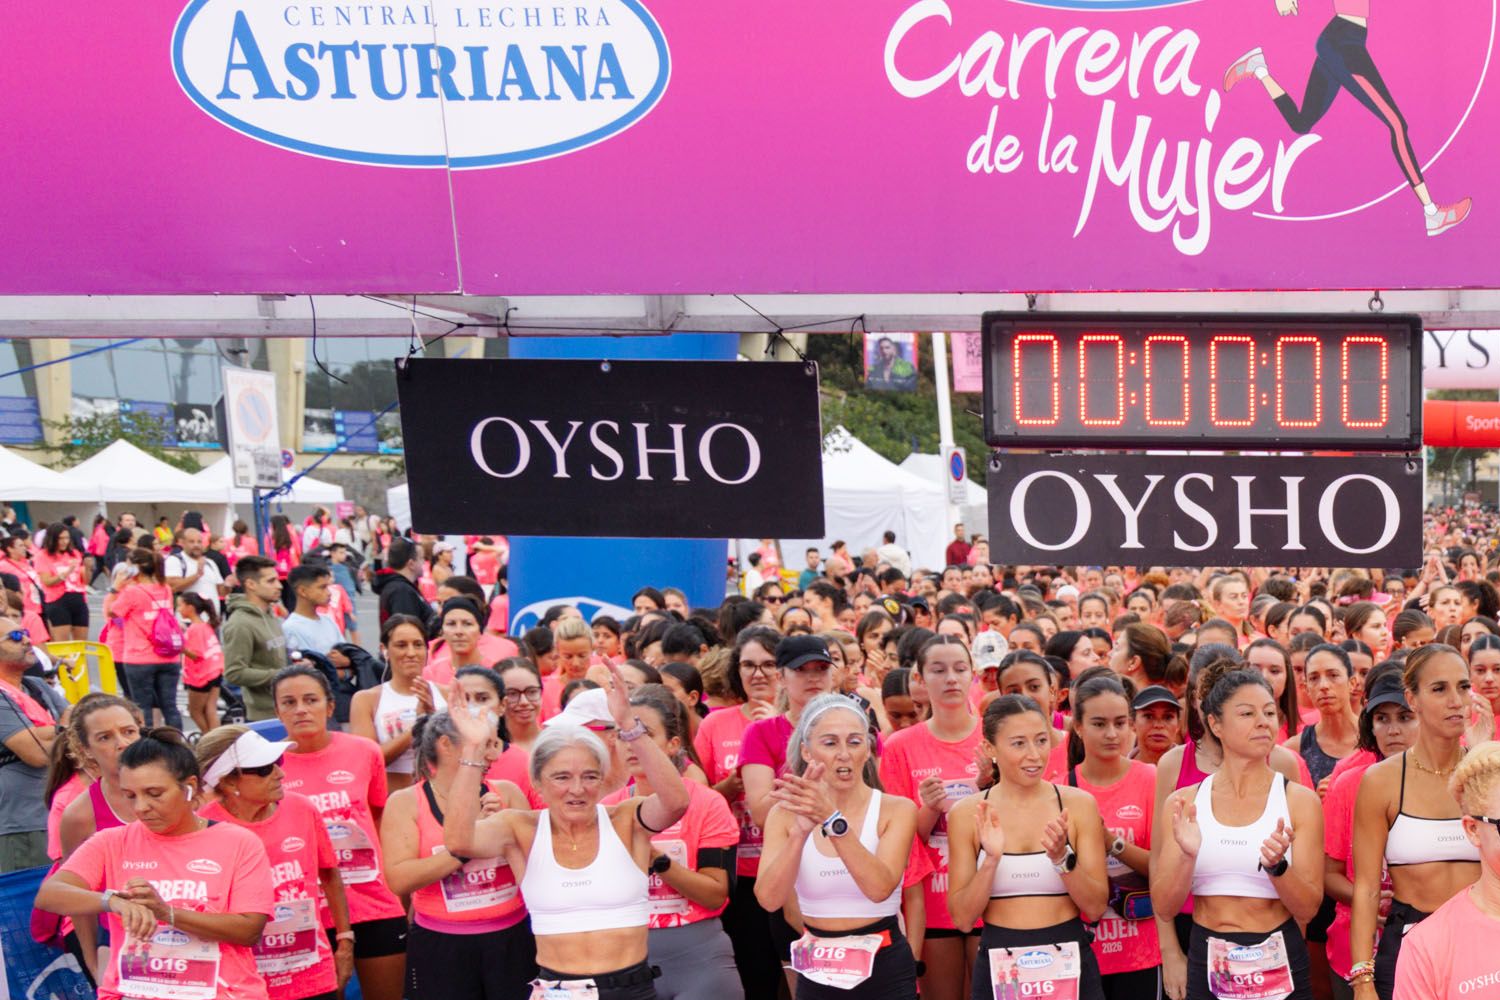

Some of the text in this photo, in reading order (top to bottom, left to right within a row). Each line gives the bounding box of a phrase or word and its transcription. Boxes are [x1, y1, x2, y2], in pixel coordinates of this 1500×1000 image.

[283, 4, 612, 28] CENTRAL LECHERA
[216, 9, 635, 101] ASTURIANA
[883, 0, 1201, 100] Carrera
[965, 101, 1079, 175] de la
[1072, 89, 1322, 255] Mujer
[1012, 333, 1389, 428] 00:00:00
[469, 416, 763, 485] OYSHO
[1008, 470, 1400, 554] OYSHO
[265, 932, 296, 947] 016
[813, 947, 846, 959] 016
[1102, 941, 1123, 953] 2026
[150, 958, 188, 972] 016
[1021, 981, 1054, 995] 016
[1233, 972, 1265, 985] 016
